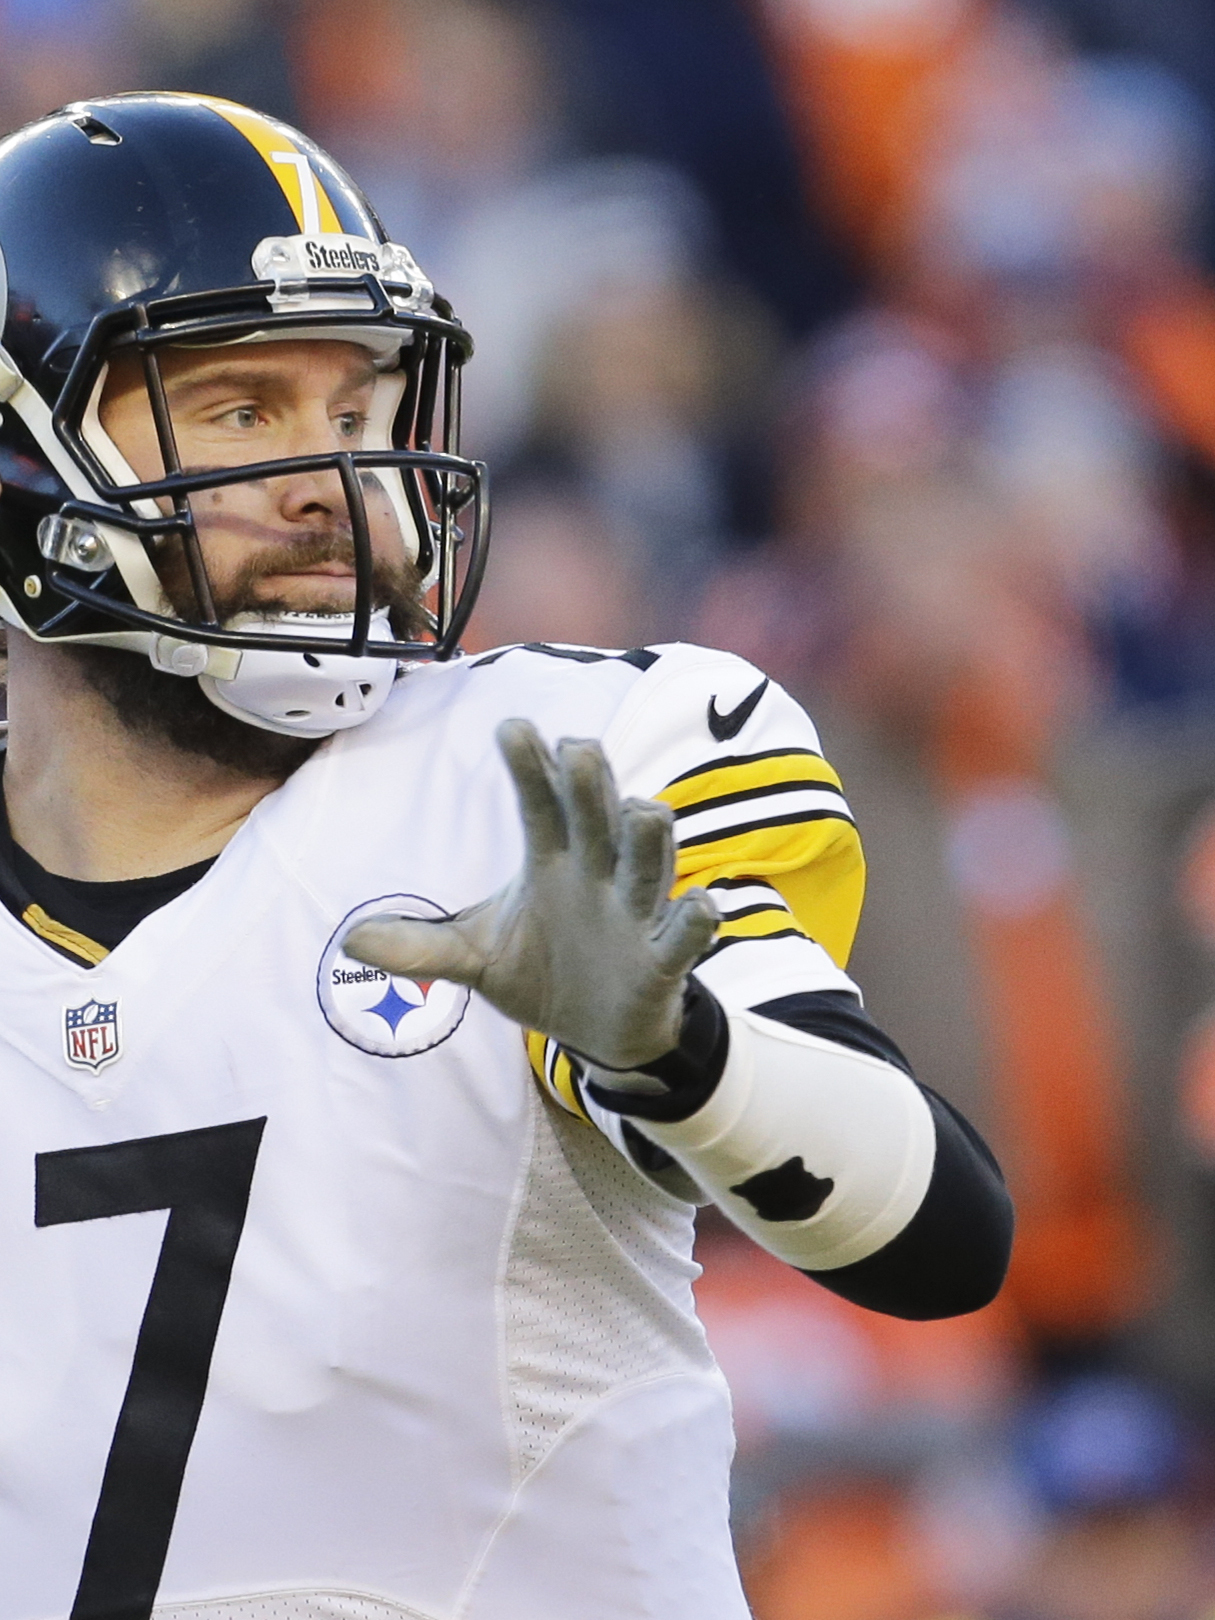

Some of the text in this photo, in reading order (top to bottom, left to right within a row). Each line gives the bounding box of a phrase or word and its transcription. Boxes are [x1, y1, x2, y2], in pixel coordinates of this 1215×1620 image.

[270, 151, 320, 236] 7
[305, 241, 380, 272] Steelers
[332, 965, 388, 985] Steelers
[71, 1026, 114, 1061] NFL
[34, 1115, 268, 1620] 7
